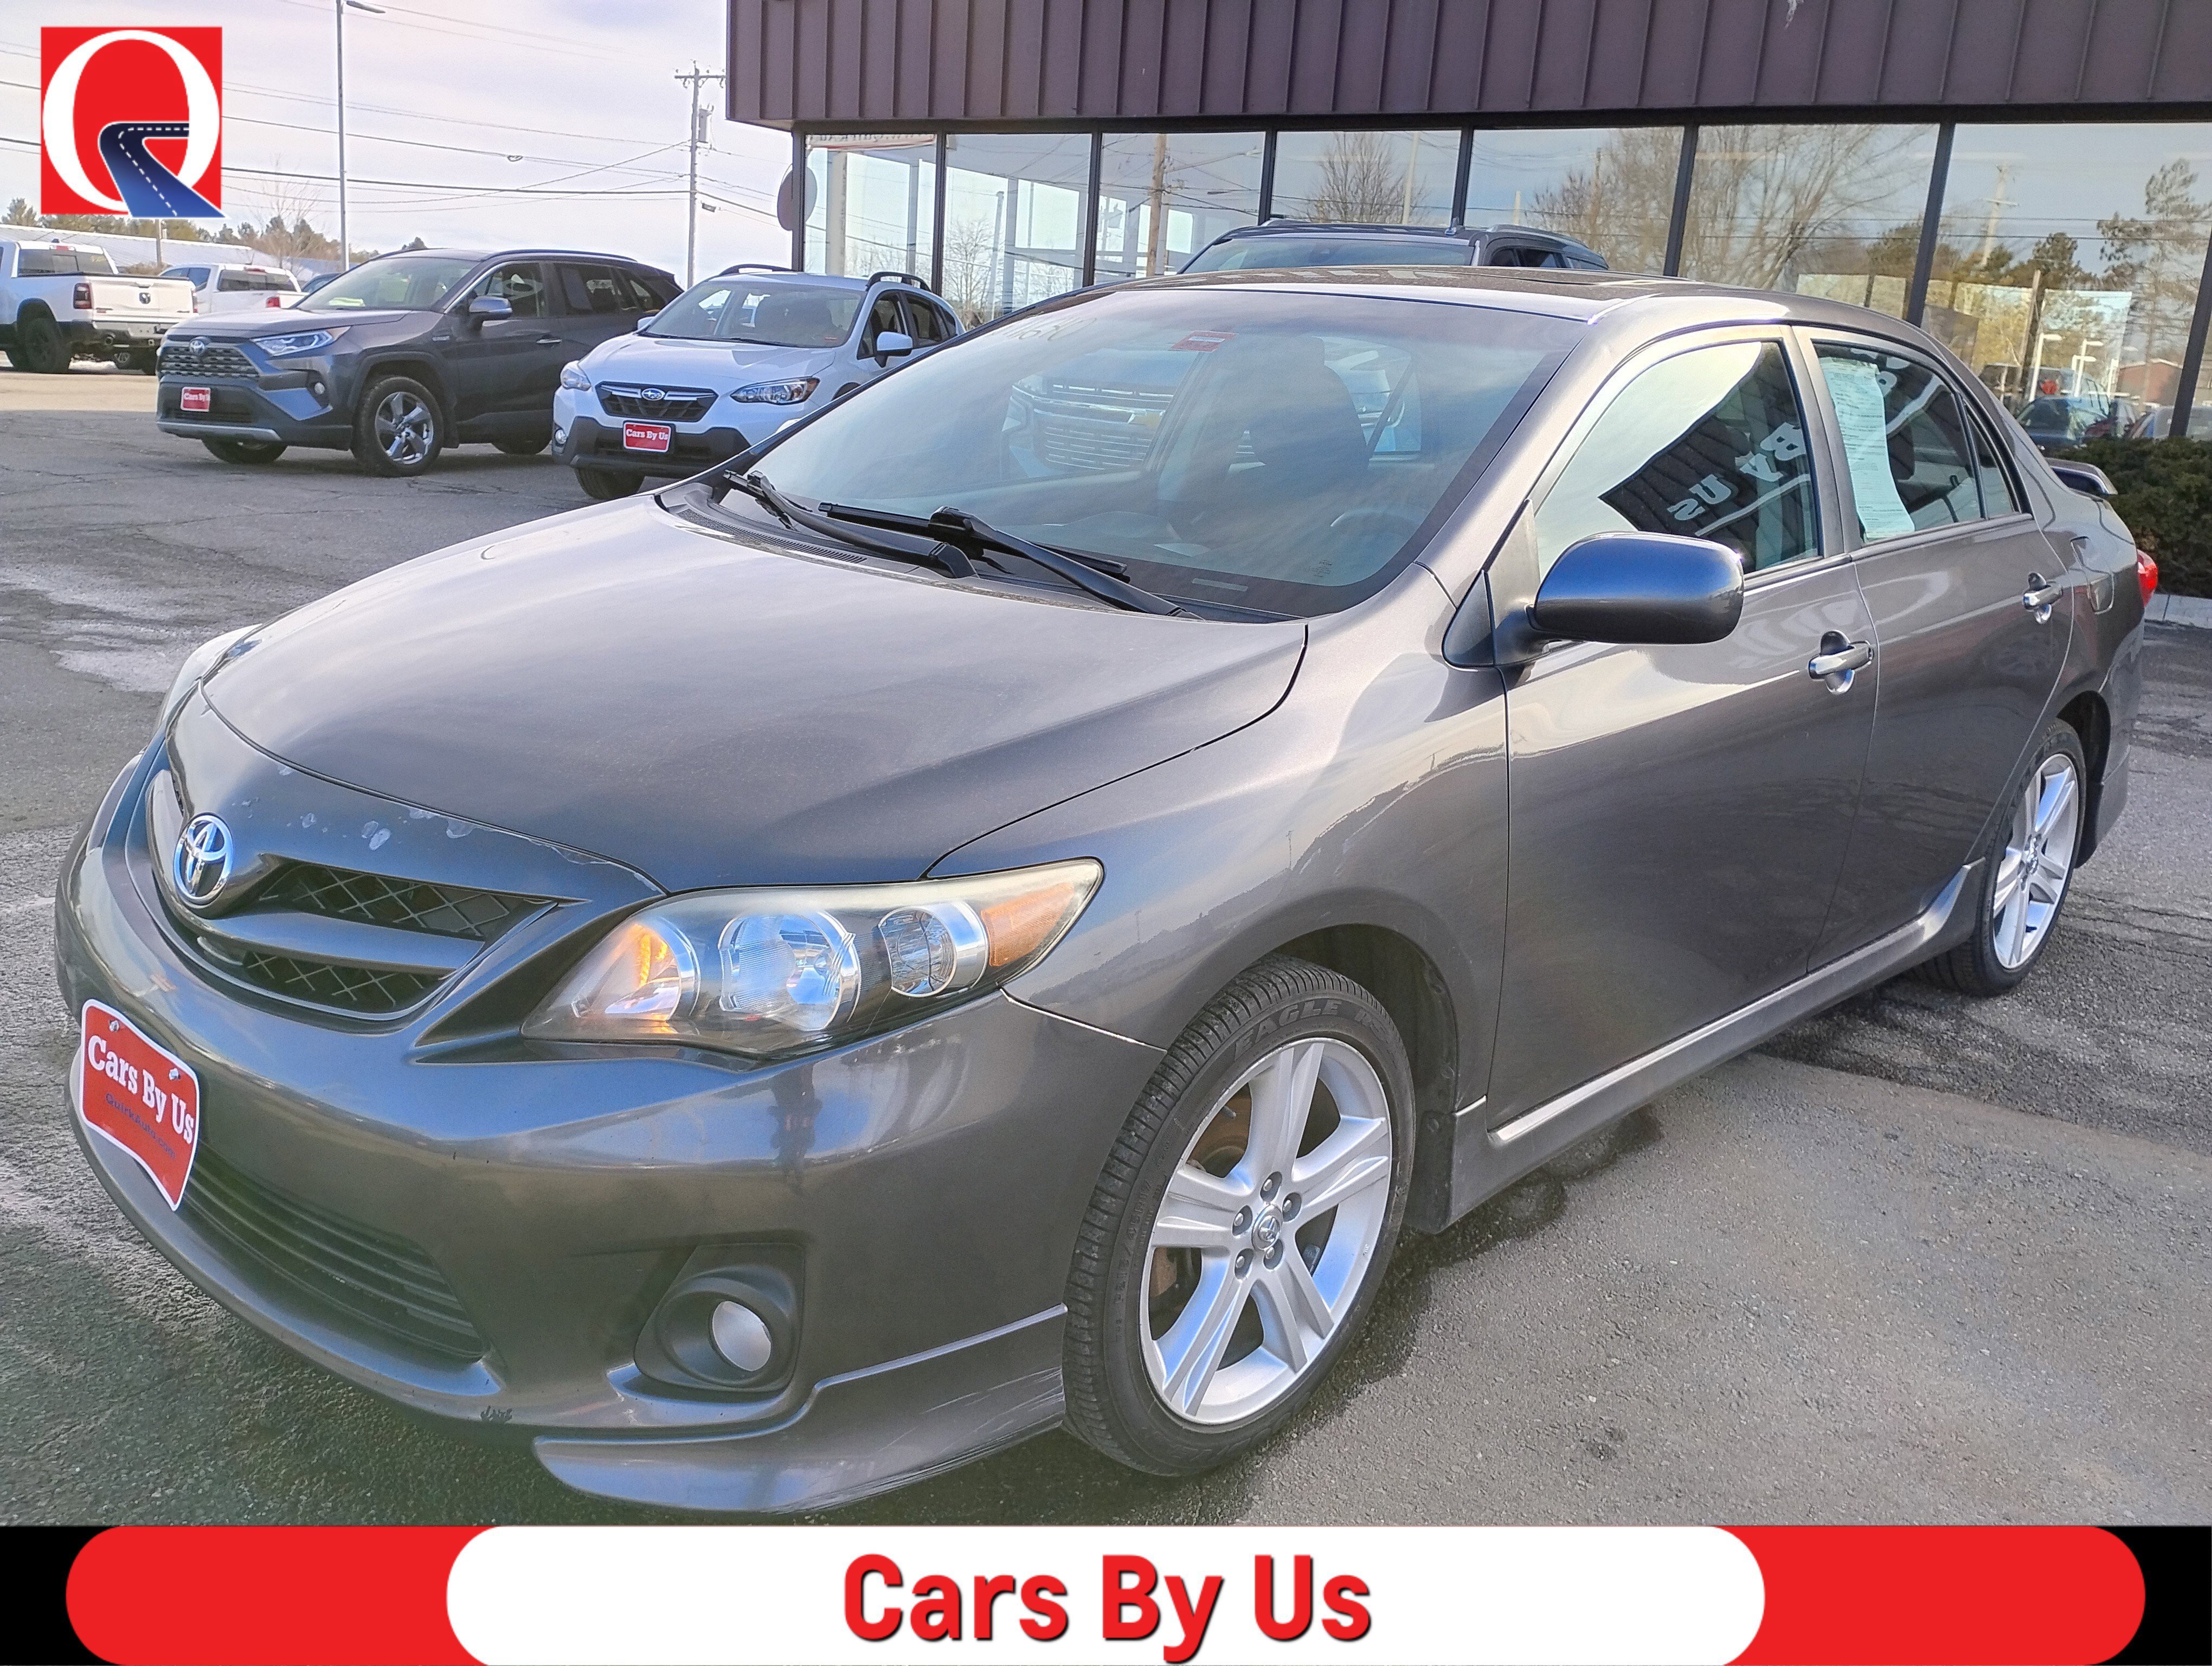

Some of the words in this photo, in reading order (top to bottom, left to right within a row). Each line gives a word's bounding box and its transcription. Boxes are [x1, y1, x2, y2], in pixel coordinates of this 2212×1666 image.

[626, 429, 645, 438] Cars
[647, 431, 657, 440] By
[1234, 999, 1342, 1061] EAGLE
[88, 1035, 138, 1094] Cars
[143, 1069, 167, 1123] By
[172, 1093, 194, 1144] Us
